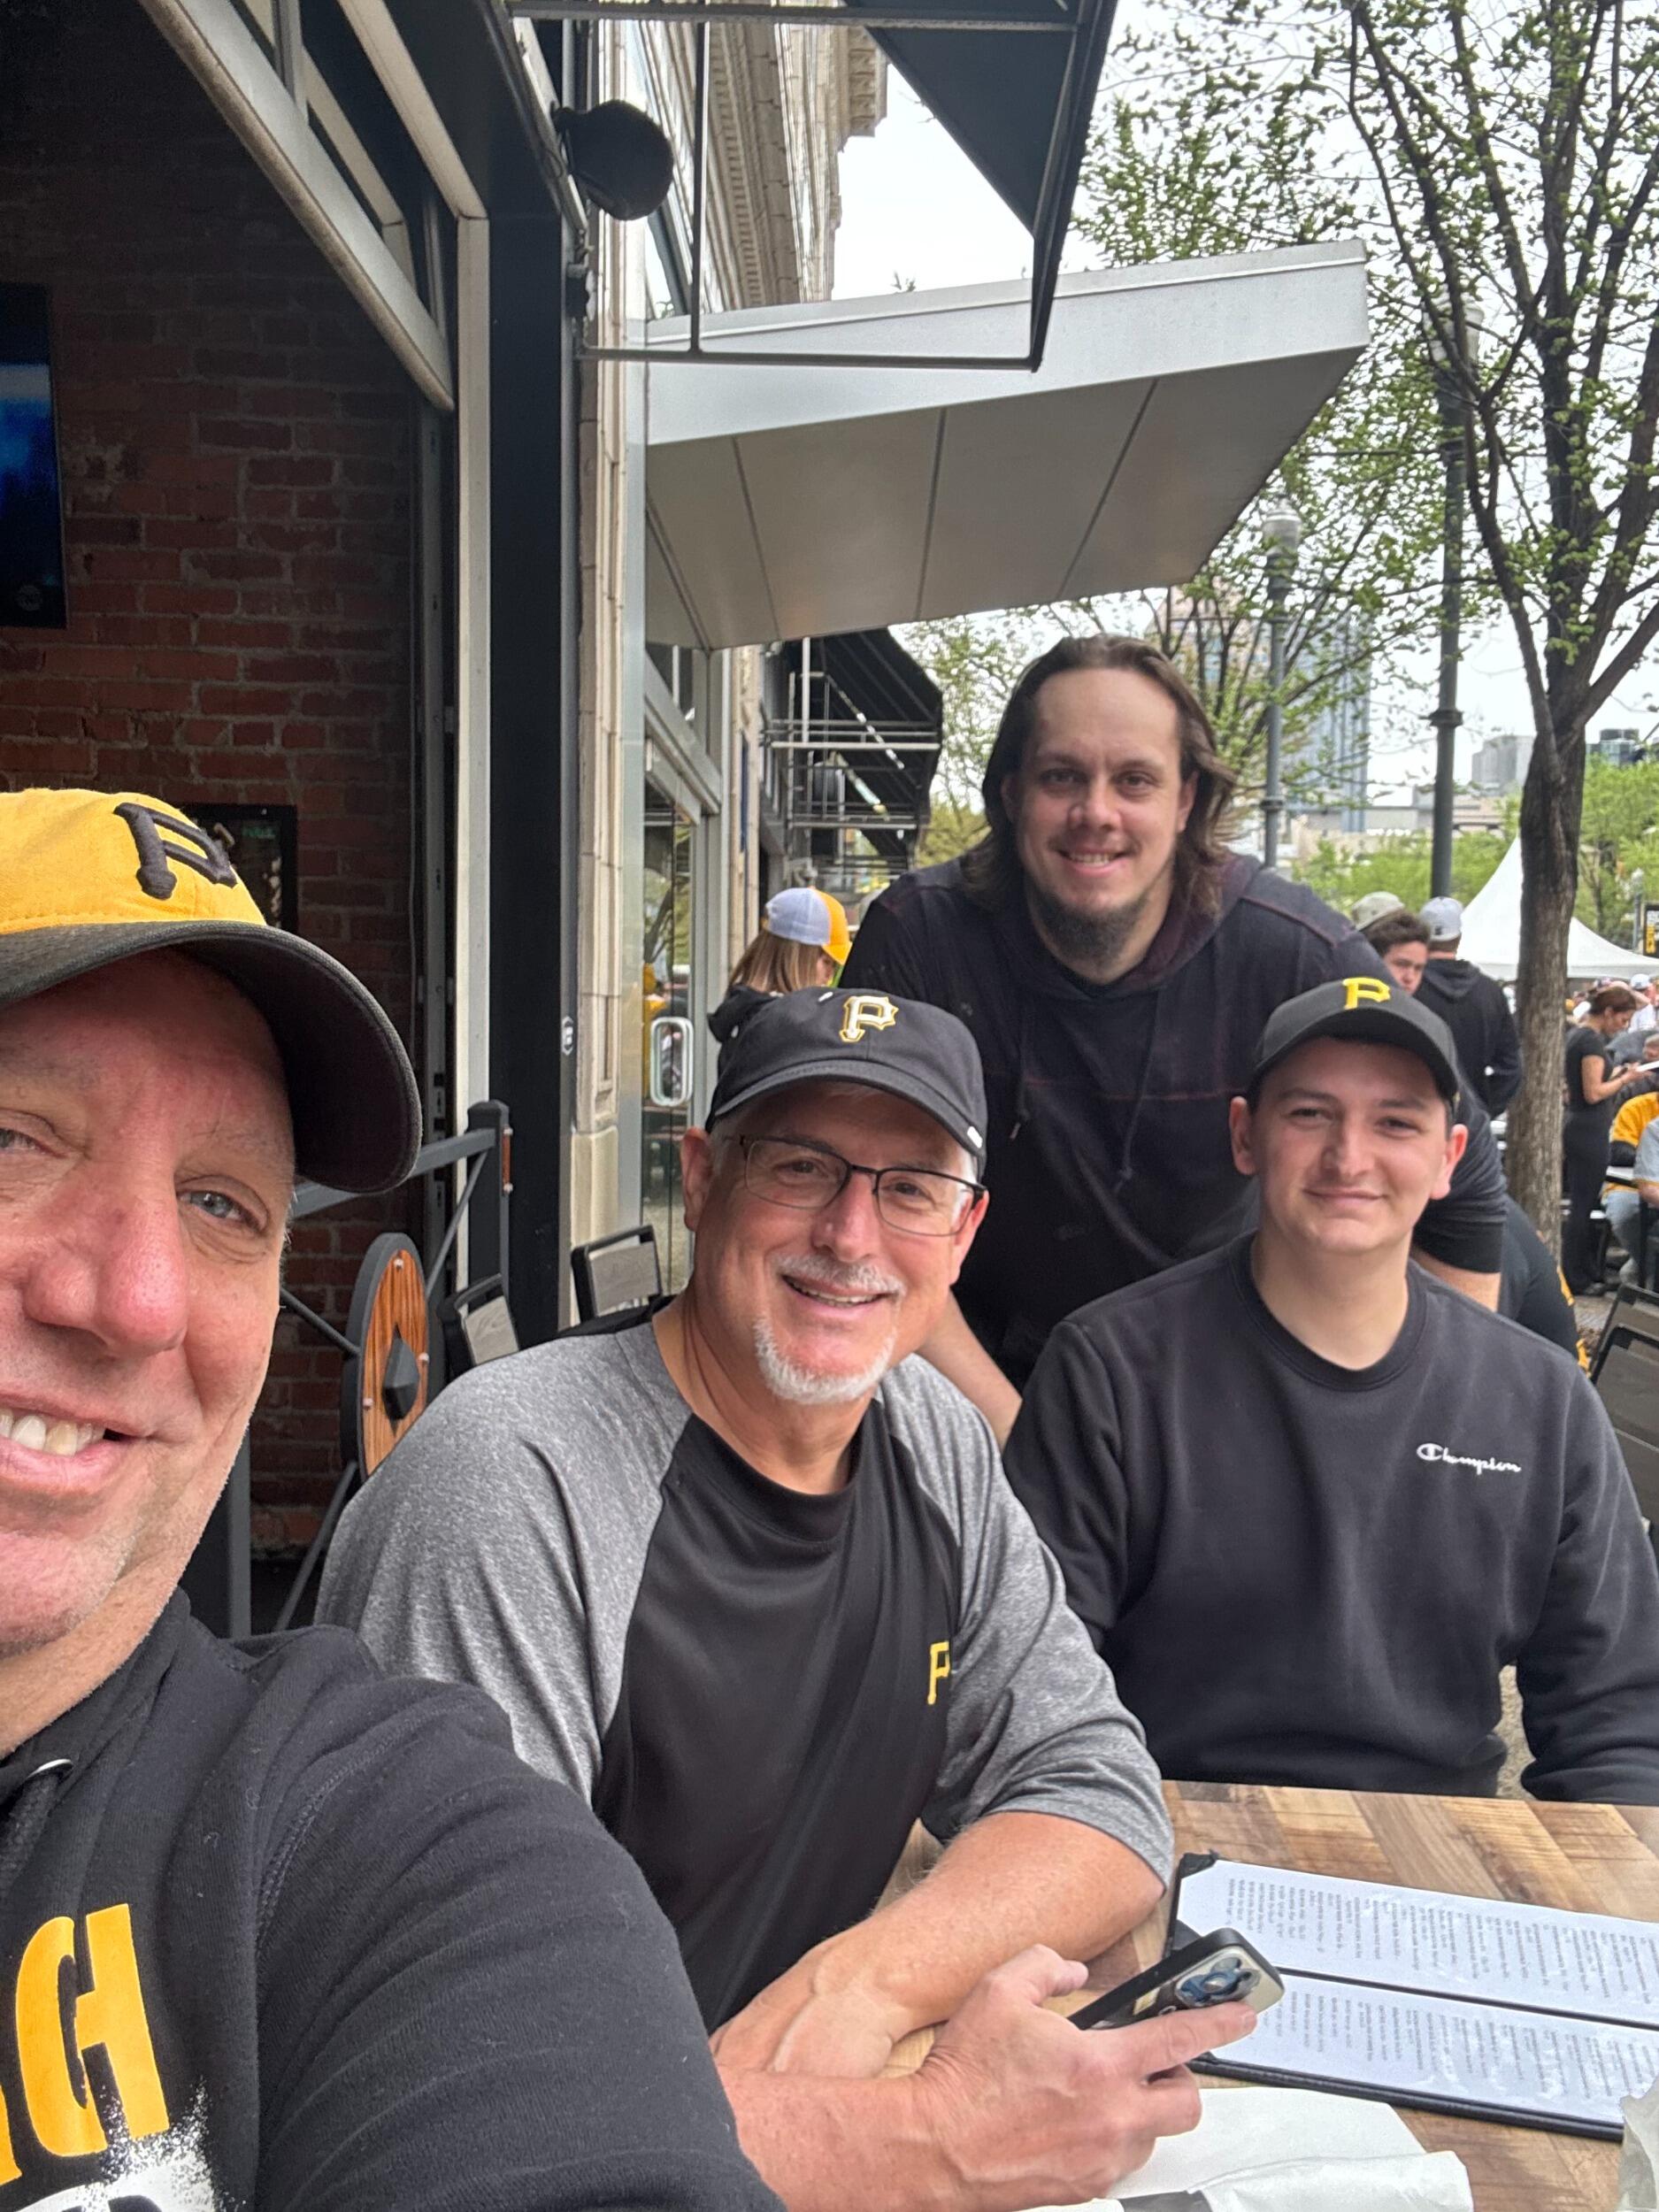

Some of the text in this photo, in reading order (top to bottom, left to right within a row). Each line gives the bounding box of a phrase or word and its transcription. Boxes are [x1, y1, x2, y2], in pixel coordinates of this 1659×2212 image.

[112, 803, 238, 901] P
[1343, 978, 1391, 1010] P
[839, 995, 899, 1042] P
[1417, 1442, 1522, 1475] Champion
